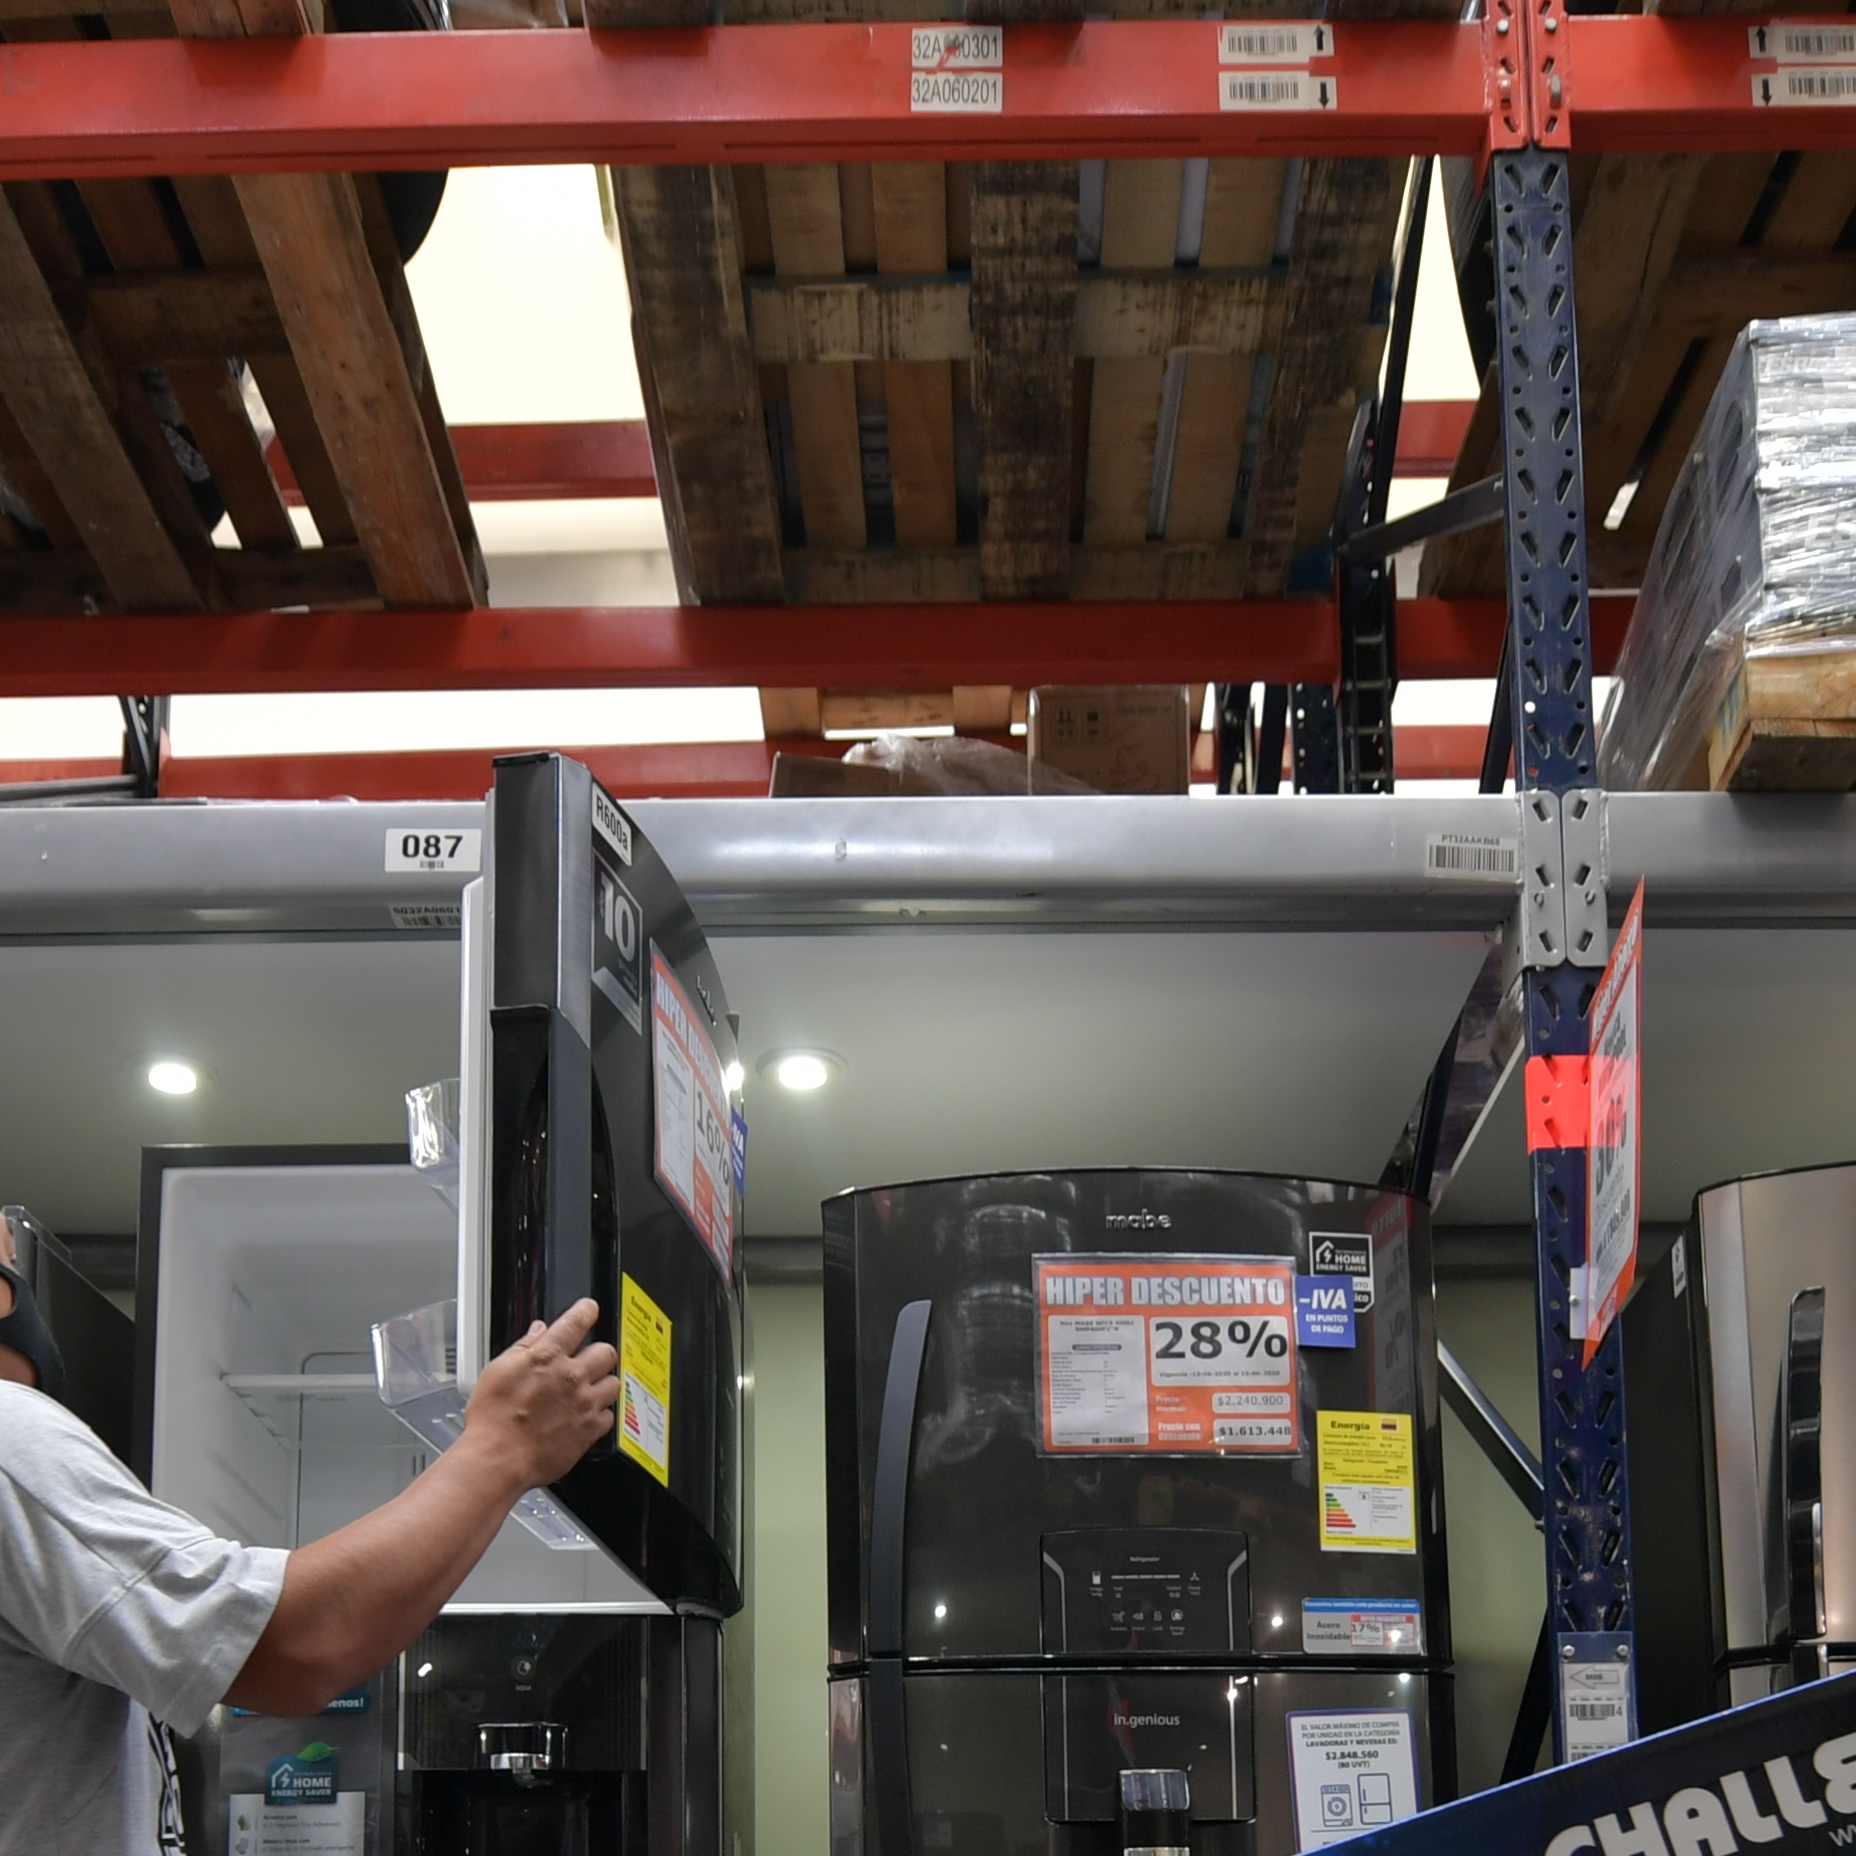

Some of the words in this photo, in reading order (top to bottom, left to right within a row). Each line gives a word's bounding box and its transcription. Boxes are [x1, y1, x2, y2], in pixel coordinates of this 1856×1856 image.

[911, 77, 999, 105] 32A060201
[596, 795, 629, 851] R600a
[401, 834, 463, 859] 087
[696, 1091, 730, 1186] 16%
[1105, 1208, 1172, 1230] mabe
[1334, 1254, 1366, 1265] HOME
[1045, 1276, 1125, 1307] HIPER
[1130, 1276, 1287, 1307] DESCUENTO
[1298, 1287, 1348, 1310] -IVA
[1153, 1319, 1288, 1360] 28%
[1216, 1394, 1285, 1408] $2.240.900
[1218, 1425, 1292, 1438] $1.613.448
[1330, 1419, 1371, 1432] Energía
[1315, 1621, 1341, 1630] Acero
[1351, 1622, 1381, 1635] 17%
[1305, 1631, 1351, 1642] Inoxidable
[1113, 1713, 1180, 1728] in.genious
[1305, 1739, 1348, 1747] LAVADORAS
[293, 1777, 332, 1788] HOME
[271, 1789, 304, 1797] ENERGY
[305, 1788, 332, 1796] SAVER
